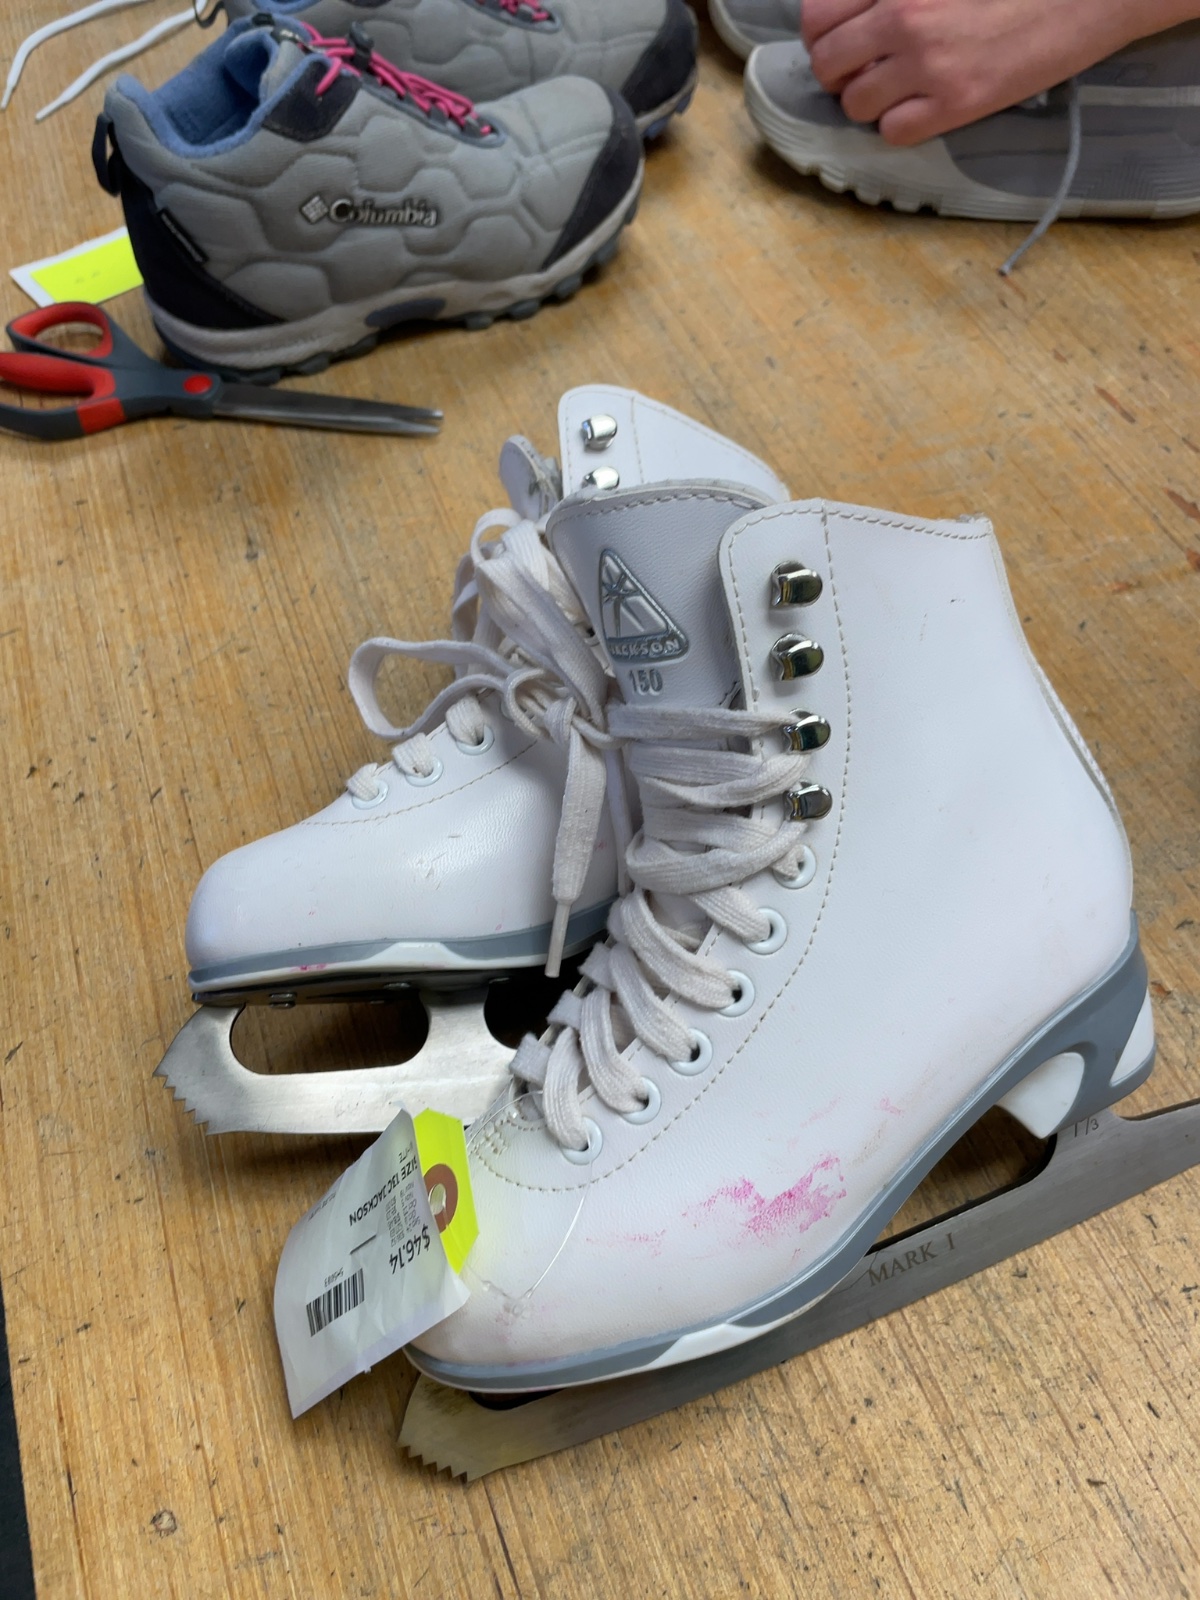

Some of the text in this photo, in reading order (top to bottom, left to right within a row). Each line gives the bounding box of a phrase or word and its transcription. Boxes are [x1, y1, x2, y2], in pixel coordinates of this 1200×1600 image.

[329, 198, 438, 228] Columbia
[629, 667, 664, 696] 150
[401, 1155, 418, 1181] SIZE
[349, 1184, 388, 1228] JACKSON
[389, 1223, 431, 1275] $46.14
[868, 1232, 955, 1287] MARK I
